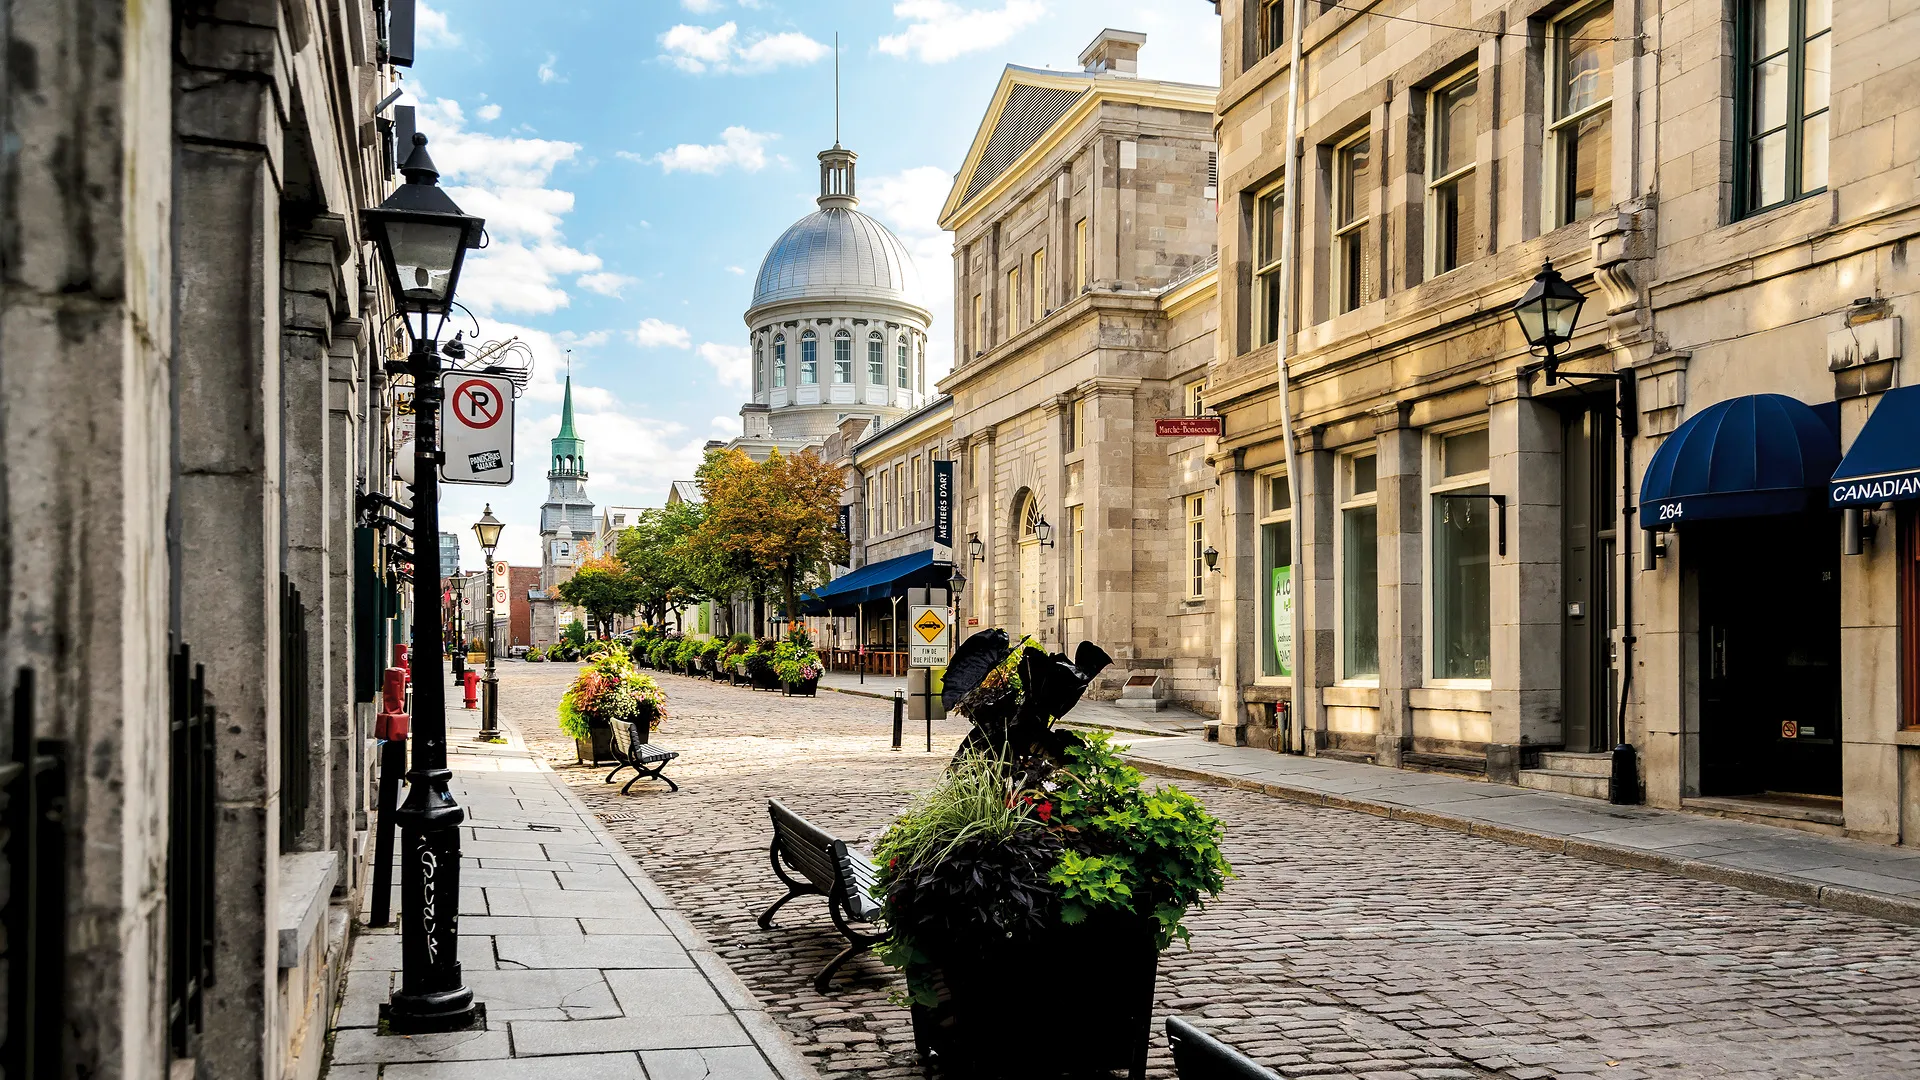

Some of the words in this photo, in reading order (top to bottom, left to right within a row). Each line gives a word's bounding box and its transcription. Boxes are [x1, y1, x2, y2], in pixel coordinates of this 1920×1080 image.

[939, 472, 948, 498] D'ART
[938, 499, 948, 539] MÉTIERS
[1659, 502, 1684, 520] 264
[1822, 571, 1831, 581] 264
[1283, 578, 1291, 596] LO
